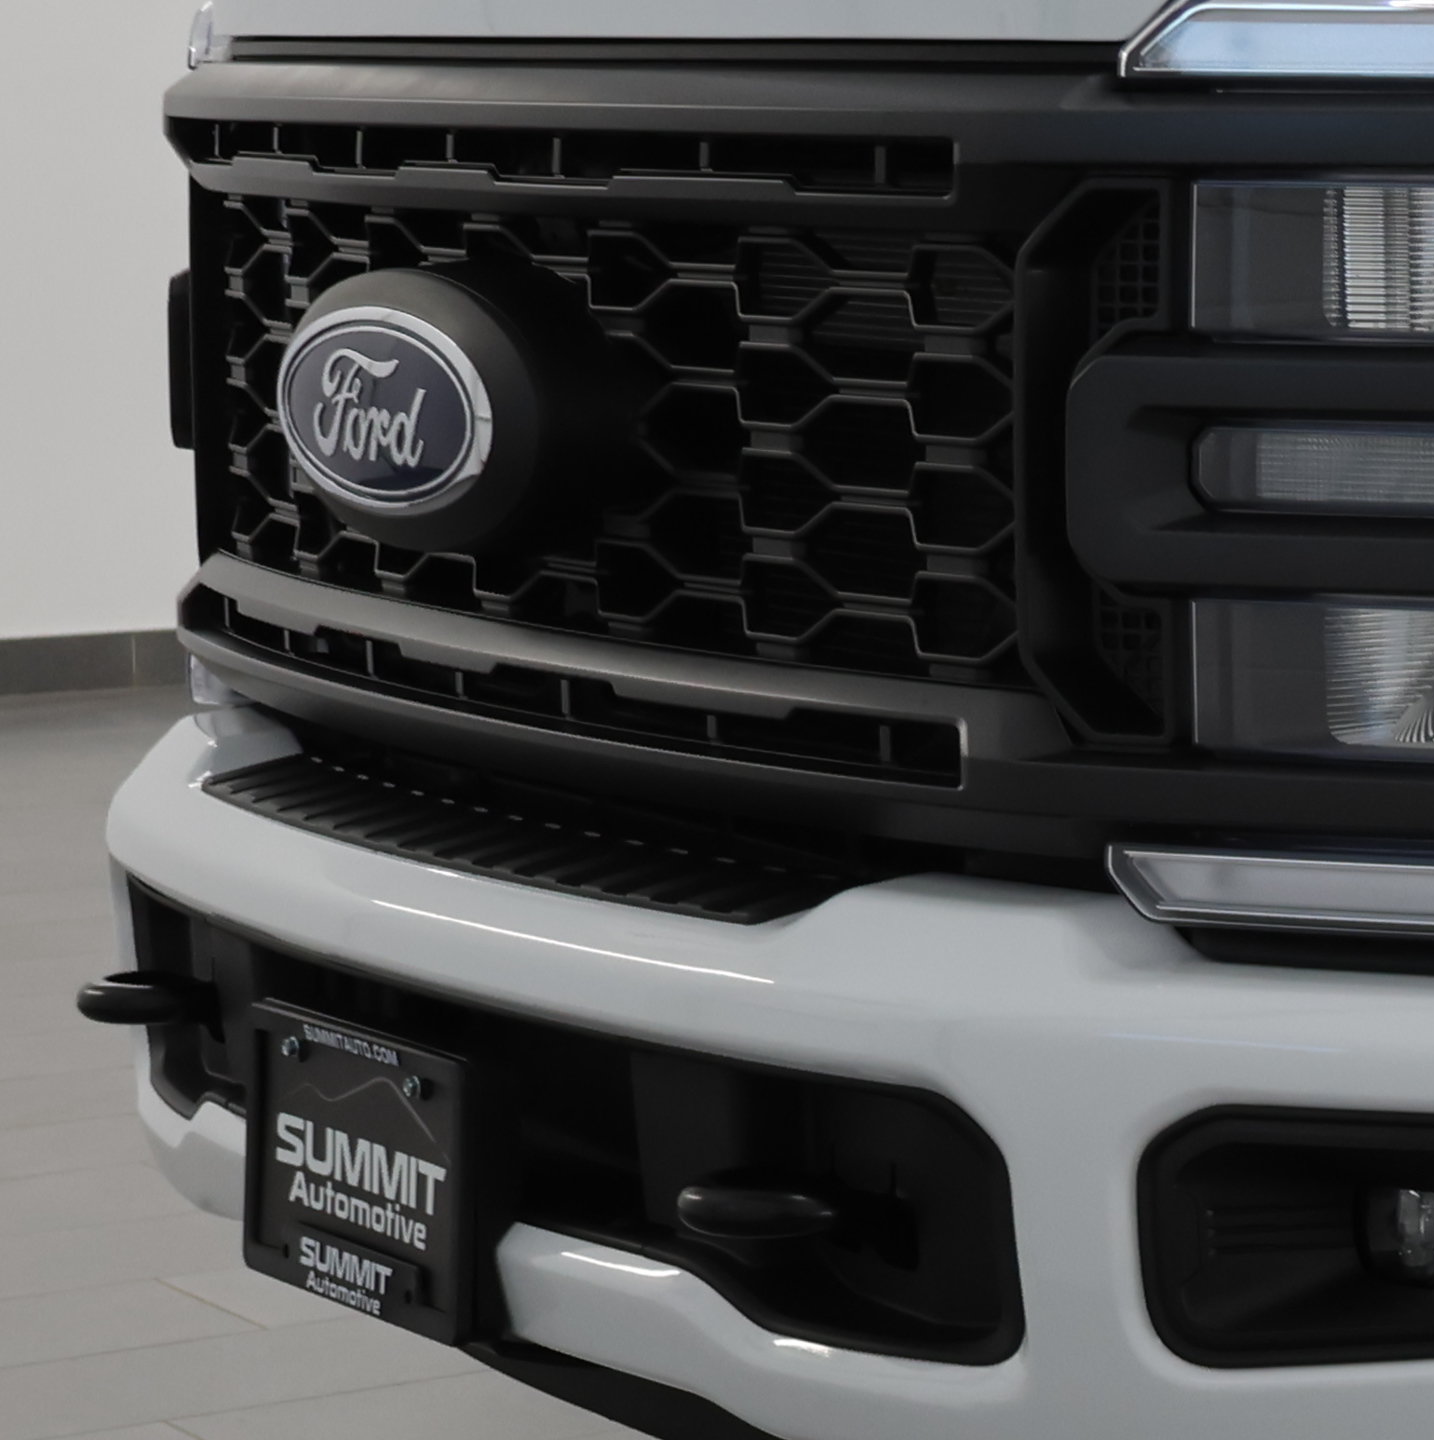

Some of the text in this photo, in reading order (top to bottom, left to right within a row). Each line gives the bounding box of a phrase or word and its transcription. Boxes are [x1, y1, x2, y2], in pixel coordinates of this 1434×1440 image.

[313, 348, 427, 468] Ford
[303, 1024, 399, 1066] SUMMITAUTO.COM
[276, 1113, 447, 1216] SUMMIT
[289, 1171, 427, 1251] Automotive
[299, 1236, 393, 1295] SUMMIT
[305, 1271, 381, 1316] Automotive
